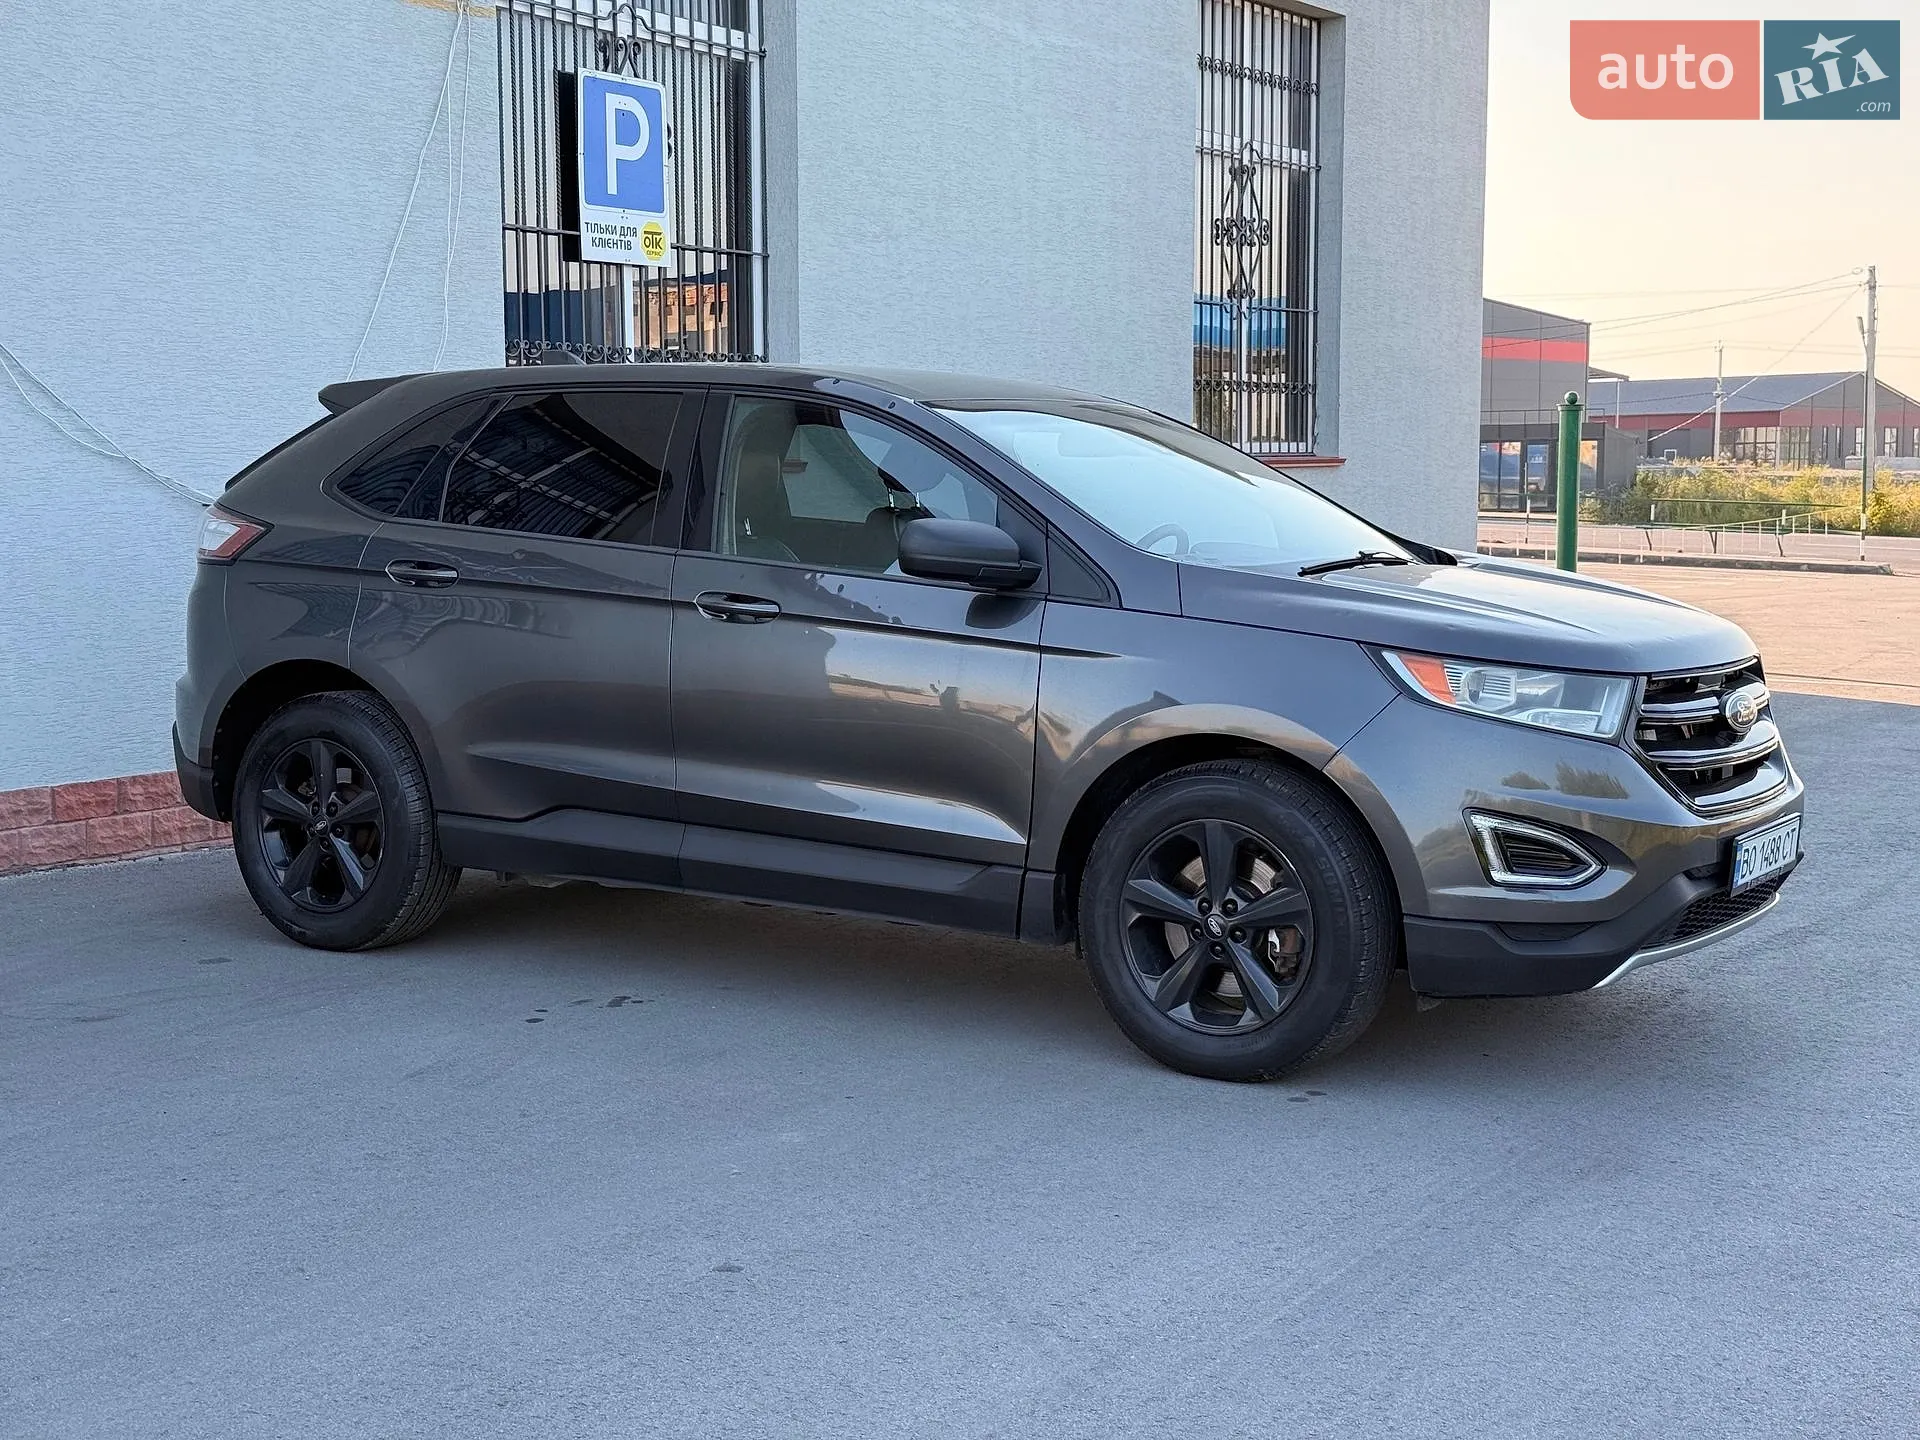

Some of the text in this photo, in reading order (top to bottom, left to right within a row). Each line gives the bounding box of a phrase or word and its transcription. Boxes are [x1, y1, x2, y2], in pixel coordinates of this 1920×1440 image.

[605, 92, 650, 196] P
[584, 222, 638, 238] ТІЛЬКИ ДЛЯ
[643, 230, 663, 250] ОТК
[591, 237, 633, 251] КЛІЄНТІВ
[1740, 827, 1797, 879] BO 1488 CT
